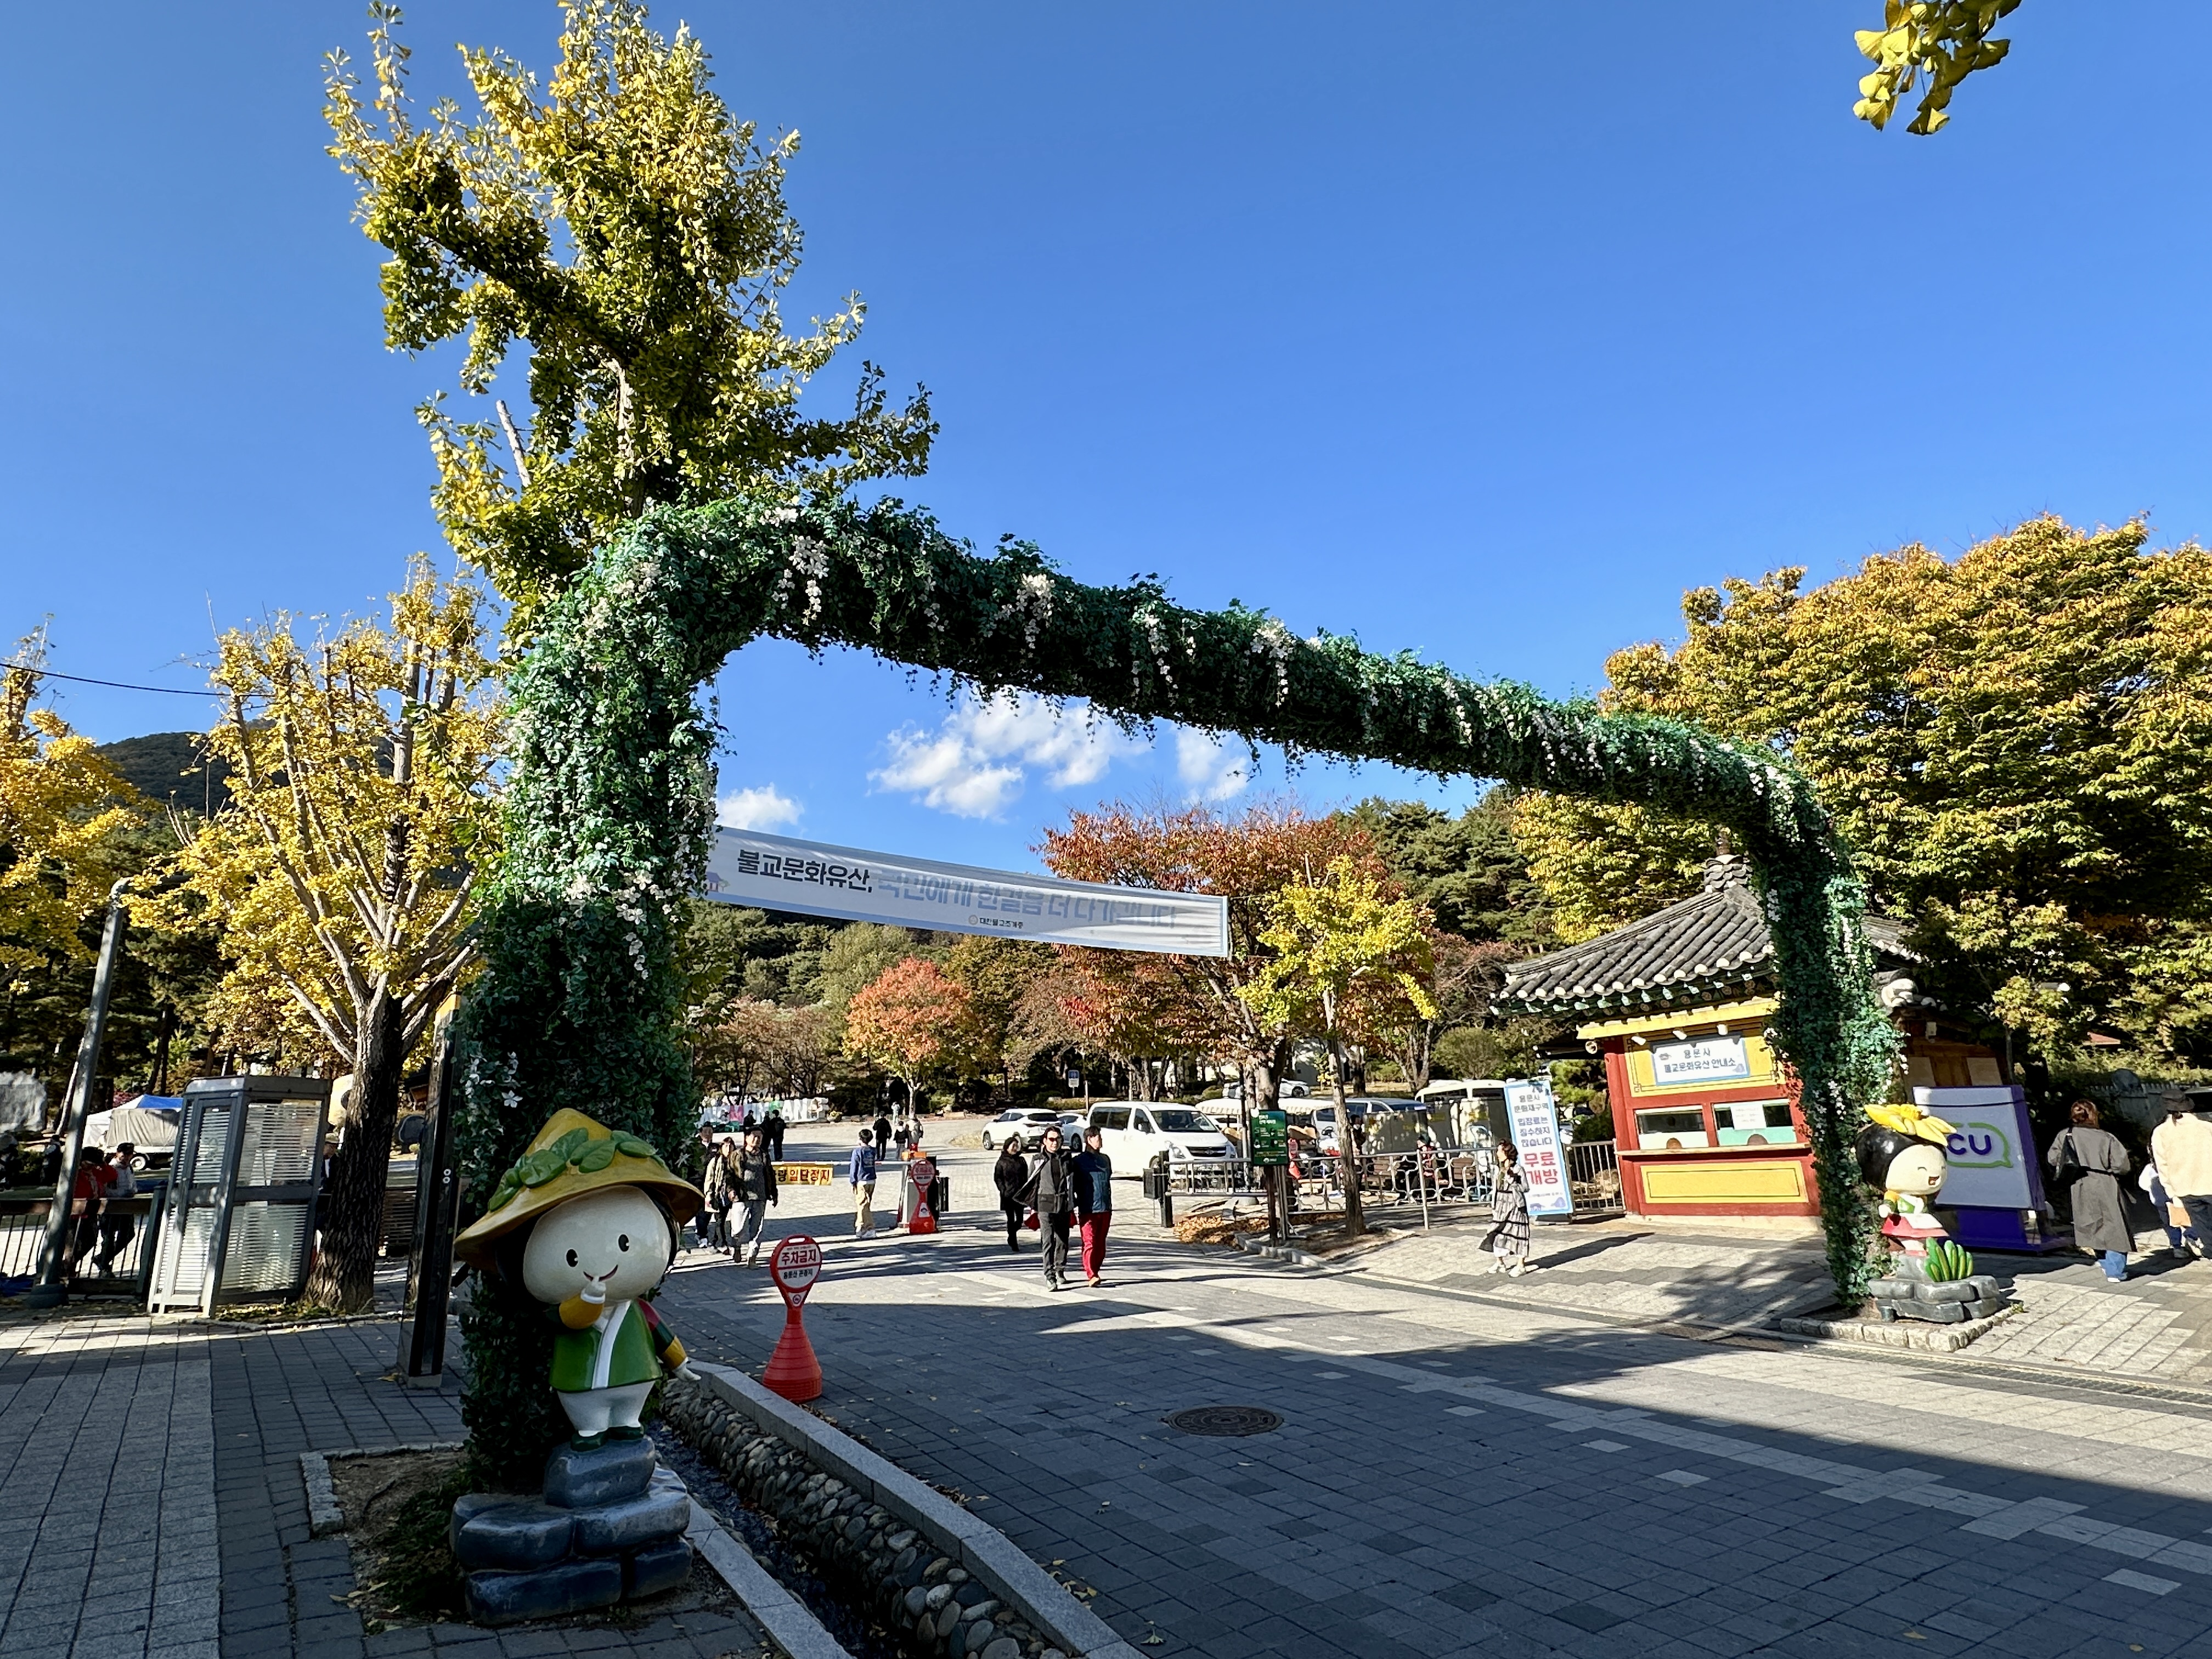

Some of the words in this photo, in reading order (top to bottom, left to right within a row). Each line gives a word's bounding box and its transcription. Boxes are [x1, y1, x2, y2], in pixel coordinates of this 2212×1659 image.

[1048, 894, 1070, 918] 더
[1711, 1058, 1736, 1068] 안내소
[1517, 1116, 1548, 1126] 입장료는
[1521, 1137, 1552, 1147] 않습니다
[1947, 1133, 1991, 1155] CU
[1524, 1152, 1556, 1167] 무료
[1526, 1169, 1558, 1184] 개방
[782, 1249, 816, 1265] 주차금지
